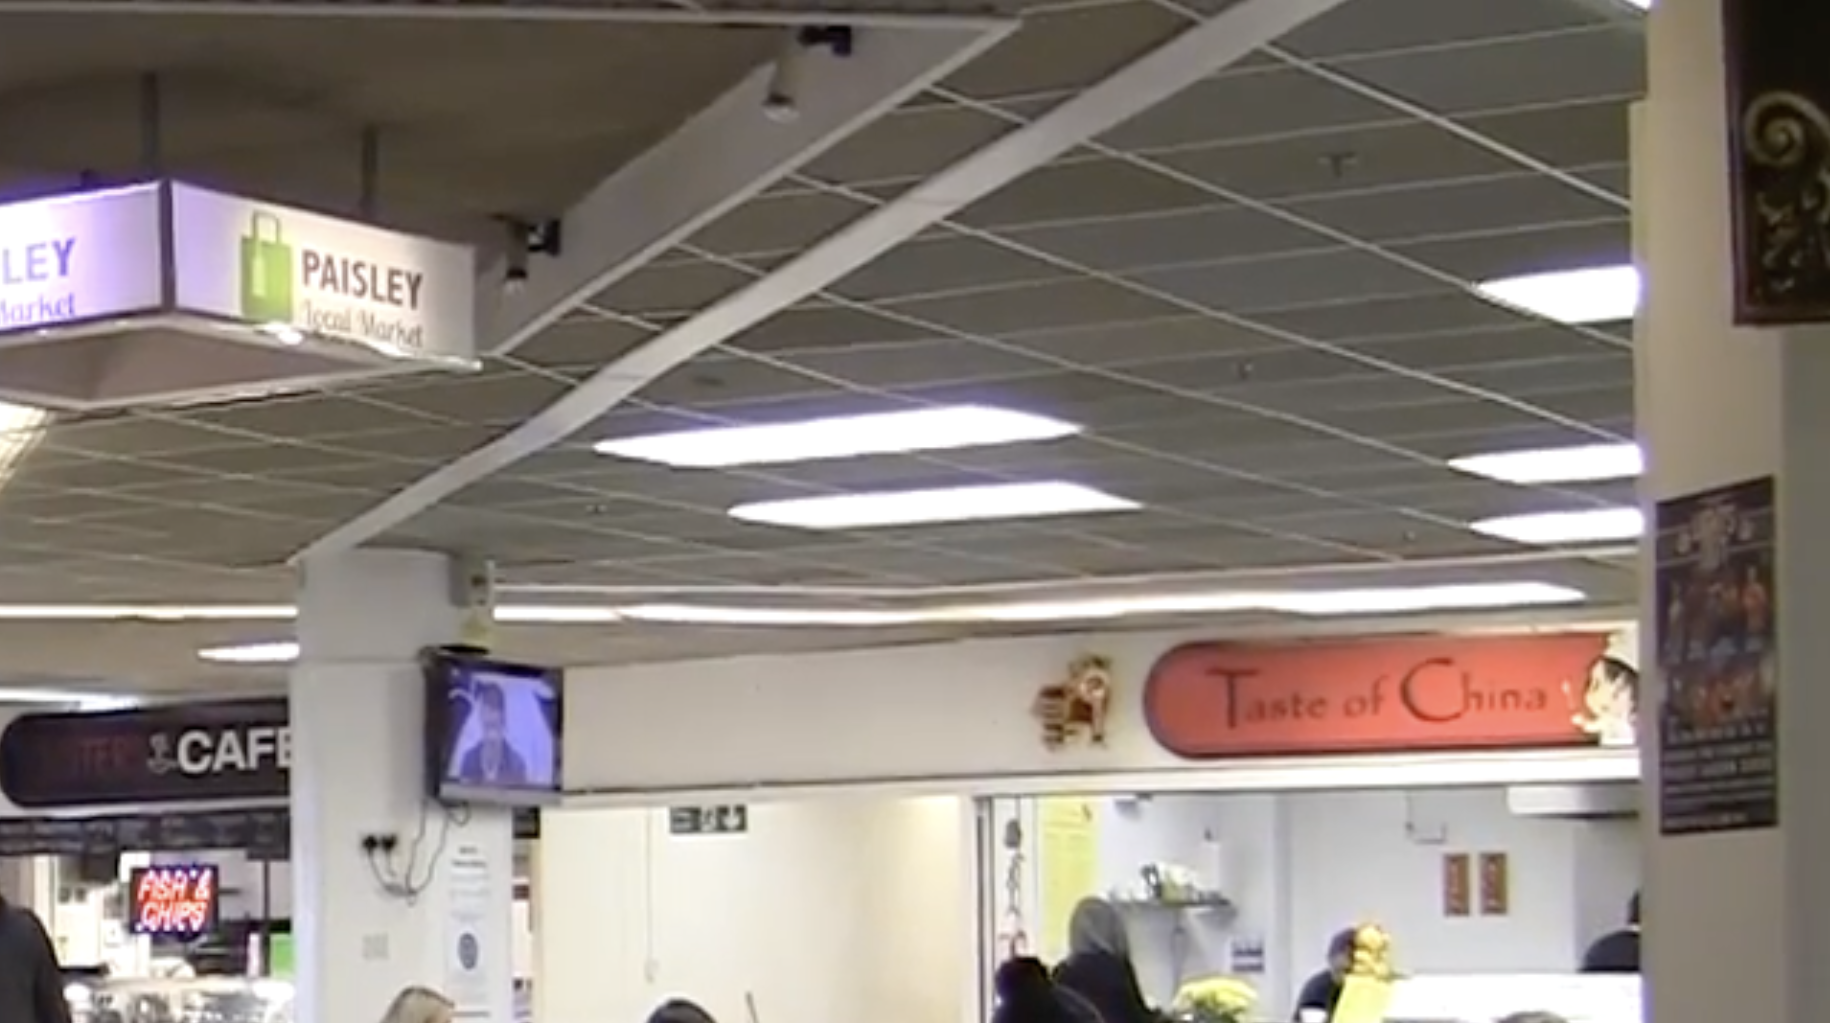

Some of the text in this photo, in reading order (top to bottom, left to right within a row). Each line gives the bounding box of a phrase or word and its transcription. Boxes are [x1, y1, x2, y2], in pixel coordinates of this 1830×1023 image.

[302, 249, 423, 311] PAISLEY
[357, 309, 424, 349] Market
[1205, 657, 1549, 730] Taste of China
[137, 869, 189, 901] FISH
[140, 900, 207, 929] CHIPS
